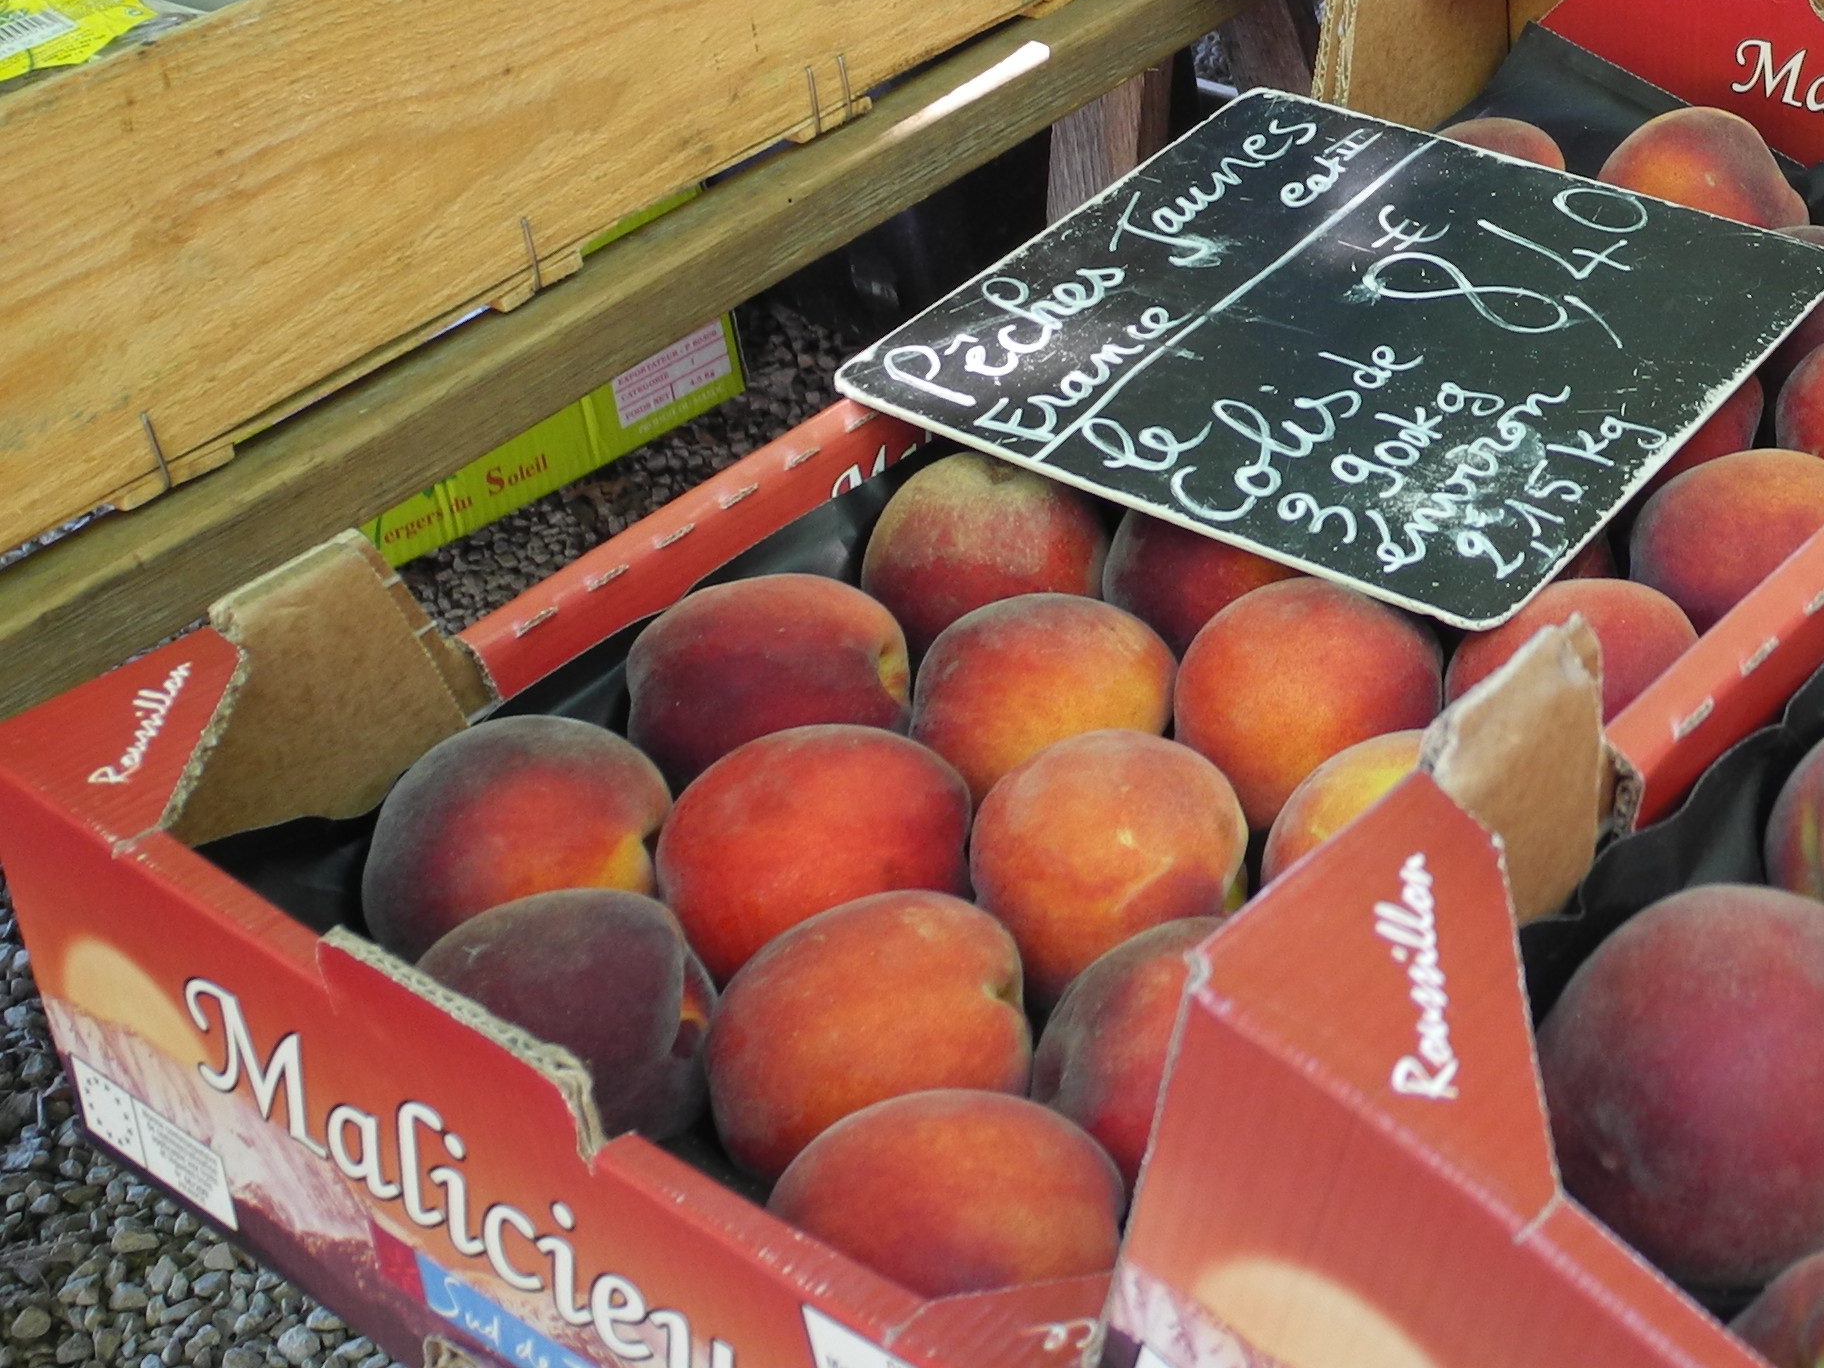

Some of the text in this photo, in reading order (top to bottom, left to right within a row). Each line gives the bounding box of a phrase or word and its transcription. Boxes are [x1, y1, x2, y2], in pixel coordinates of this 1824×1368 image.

[883, 118, 1318, 407] Pêches Jaunes
[974, 303, 1197, 443] France
[383, 507, 445, 546] ergers
[484, 453, 550, 498] Soleil
[88, 659, 193, 787] Roussillon
[1389, 851, 1458, 1101] Roussillon
